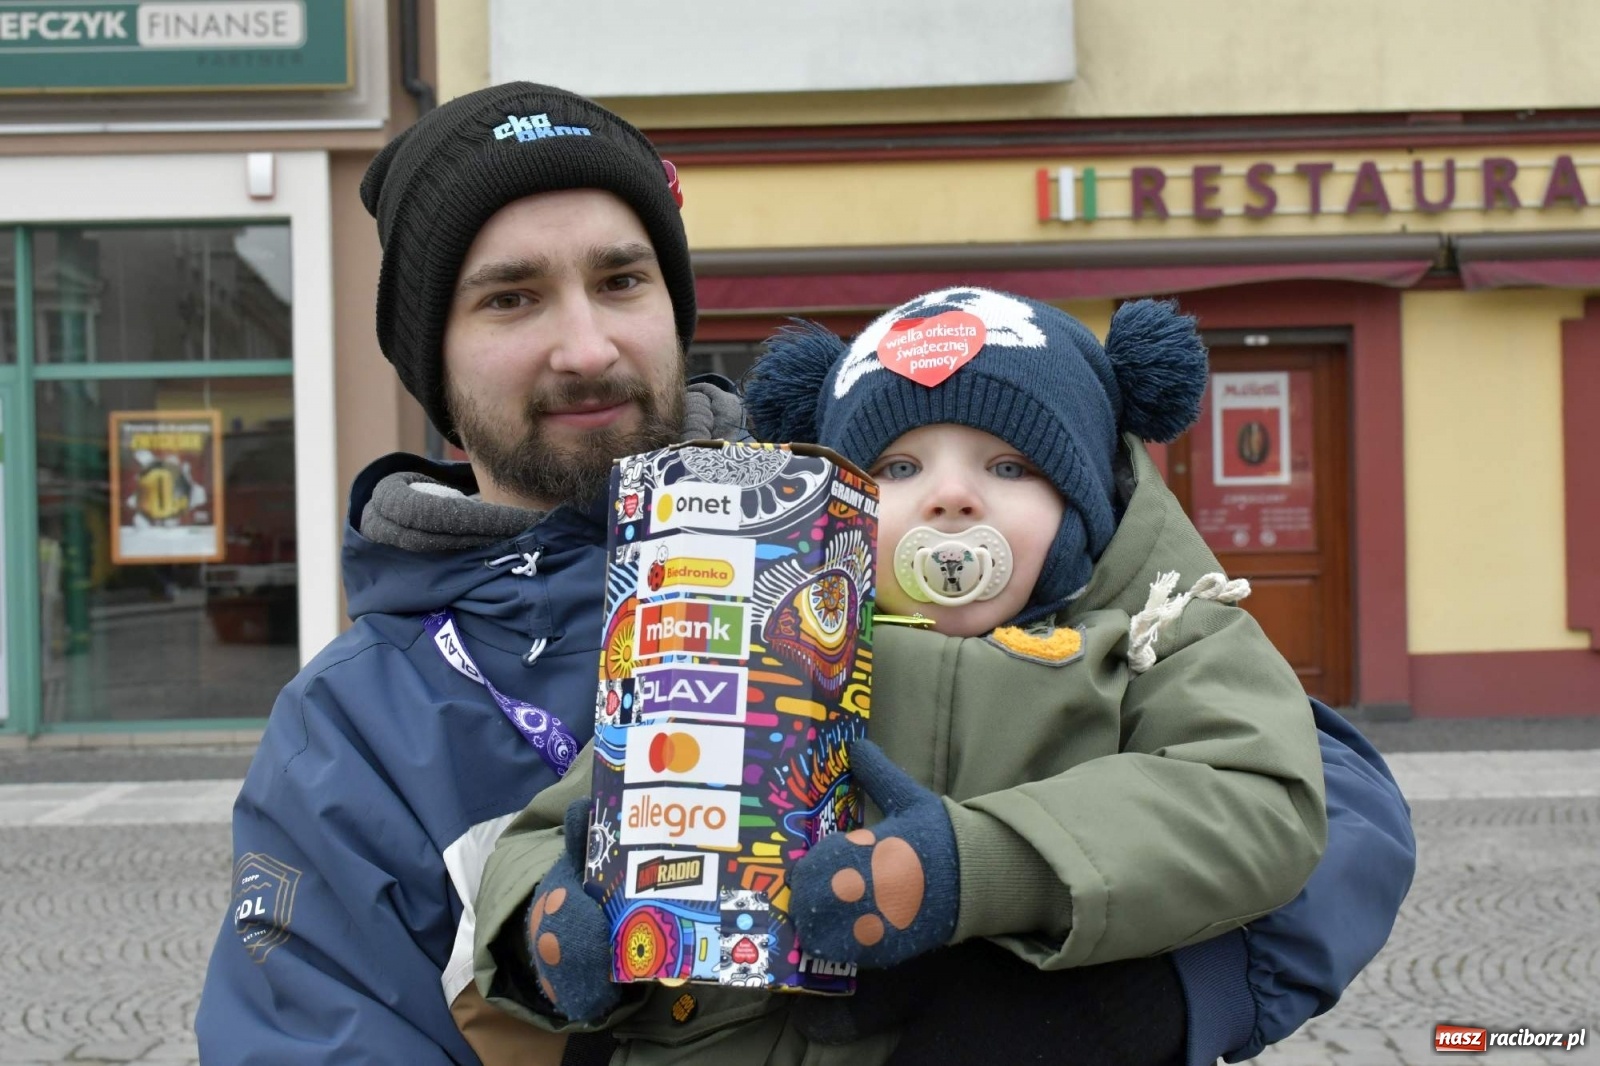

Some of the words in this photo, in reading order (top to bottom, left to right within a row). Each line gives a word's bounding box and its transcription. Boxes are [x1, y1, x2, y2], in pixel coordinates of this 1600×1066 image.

[147, 10, 288, 38] FINANSE
[1130, 154, 1589, 222] RESTAURA
[885, 327, 923, 349] wielka
[925, 323, 977, 337] orkiestra
[896, 339, 969, 361] świątecznej
[910, 355, 958, 374] pomocy
[676, 495, 731, 515] onet
[830, 480, 865, 510] GRAMY
[667, 566, 728, 580] Biedronka
[646, 617, 730, 642] mBank
[641, 679, 728, 704] PLAY
[627, 795, 727, 837] allegro
